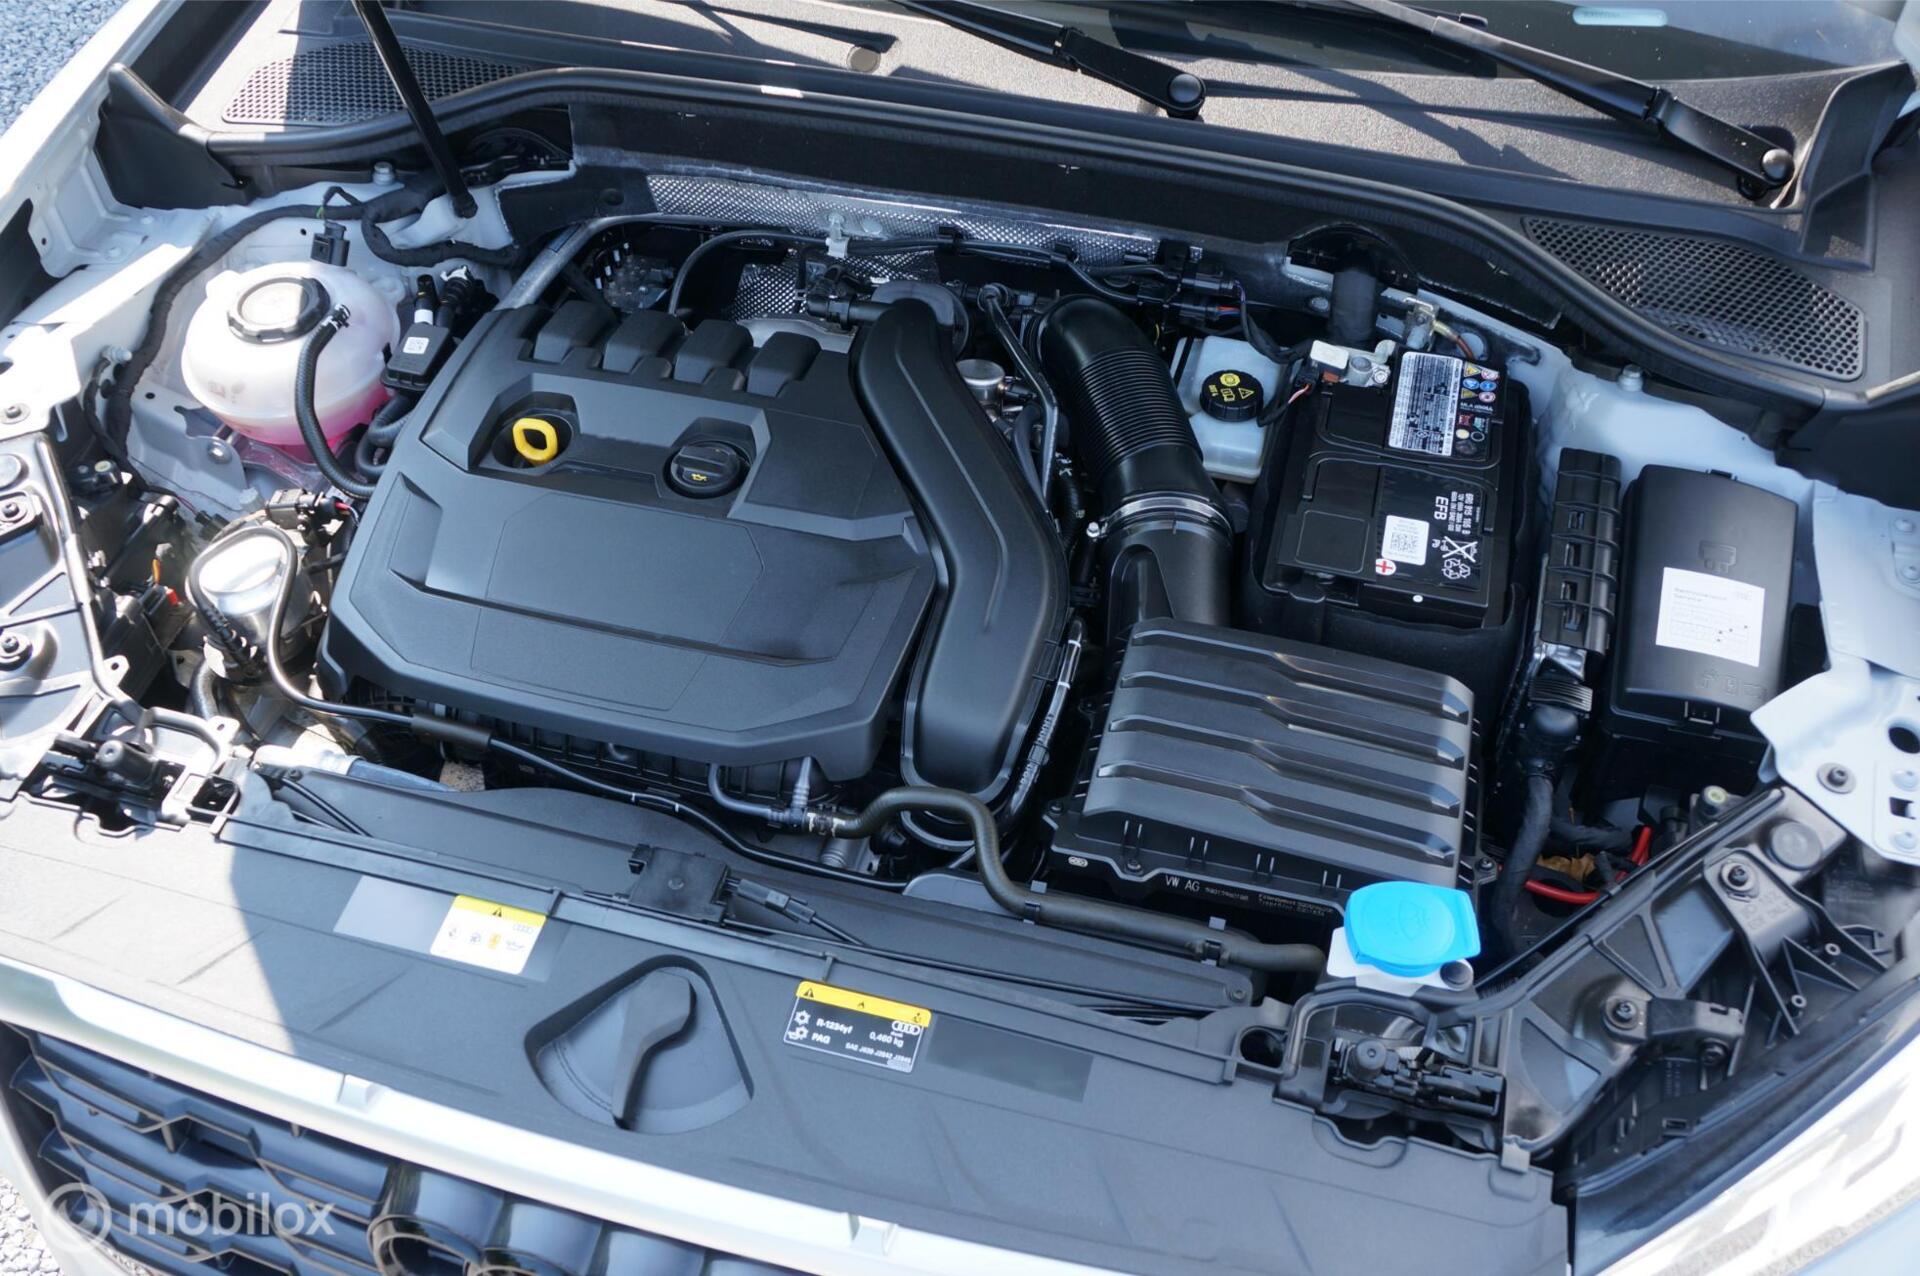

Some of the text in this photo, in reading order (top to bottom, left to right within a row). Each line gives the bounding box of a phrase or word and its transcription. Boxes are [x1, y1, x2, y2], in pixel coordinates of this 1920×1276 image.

[1433, 496, 1449, 520] EFB
[1165, 875, 1200, 892] VW AG
[811, 1032, 831, 1045] PAG
